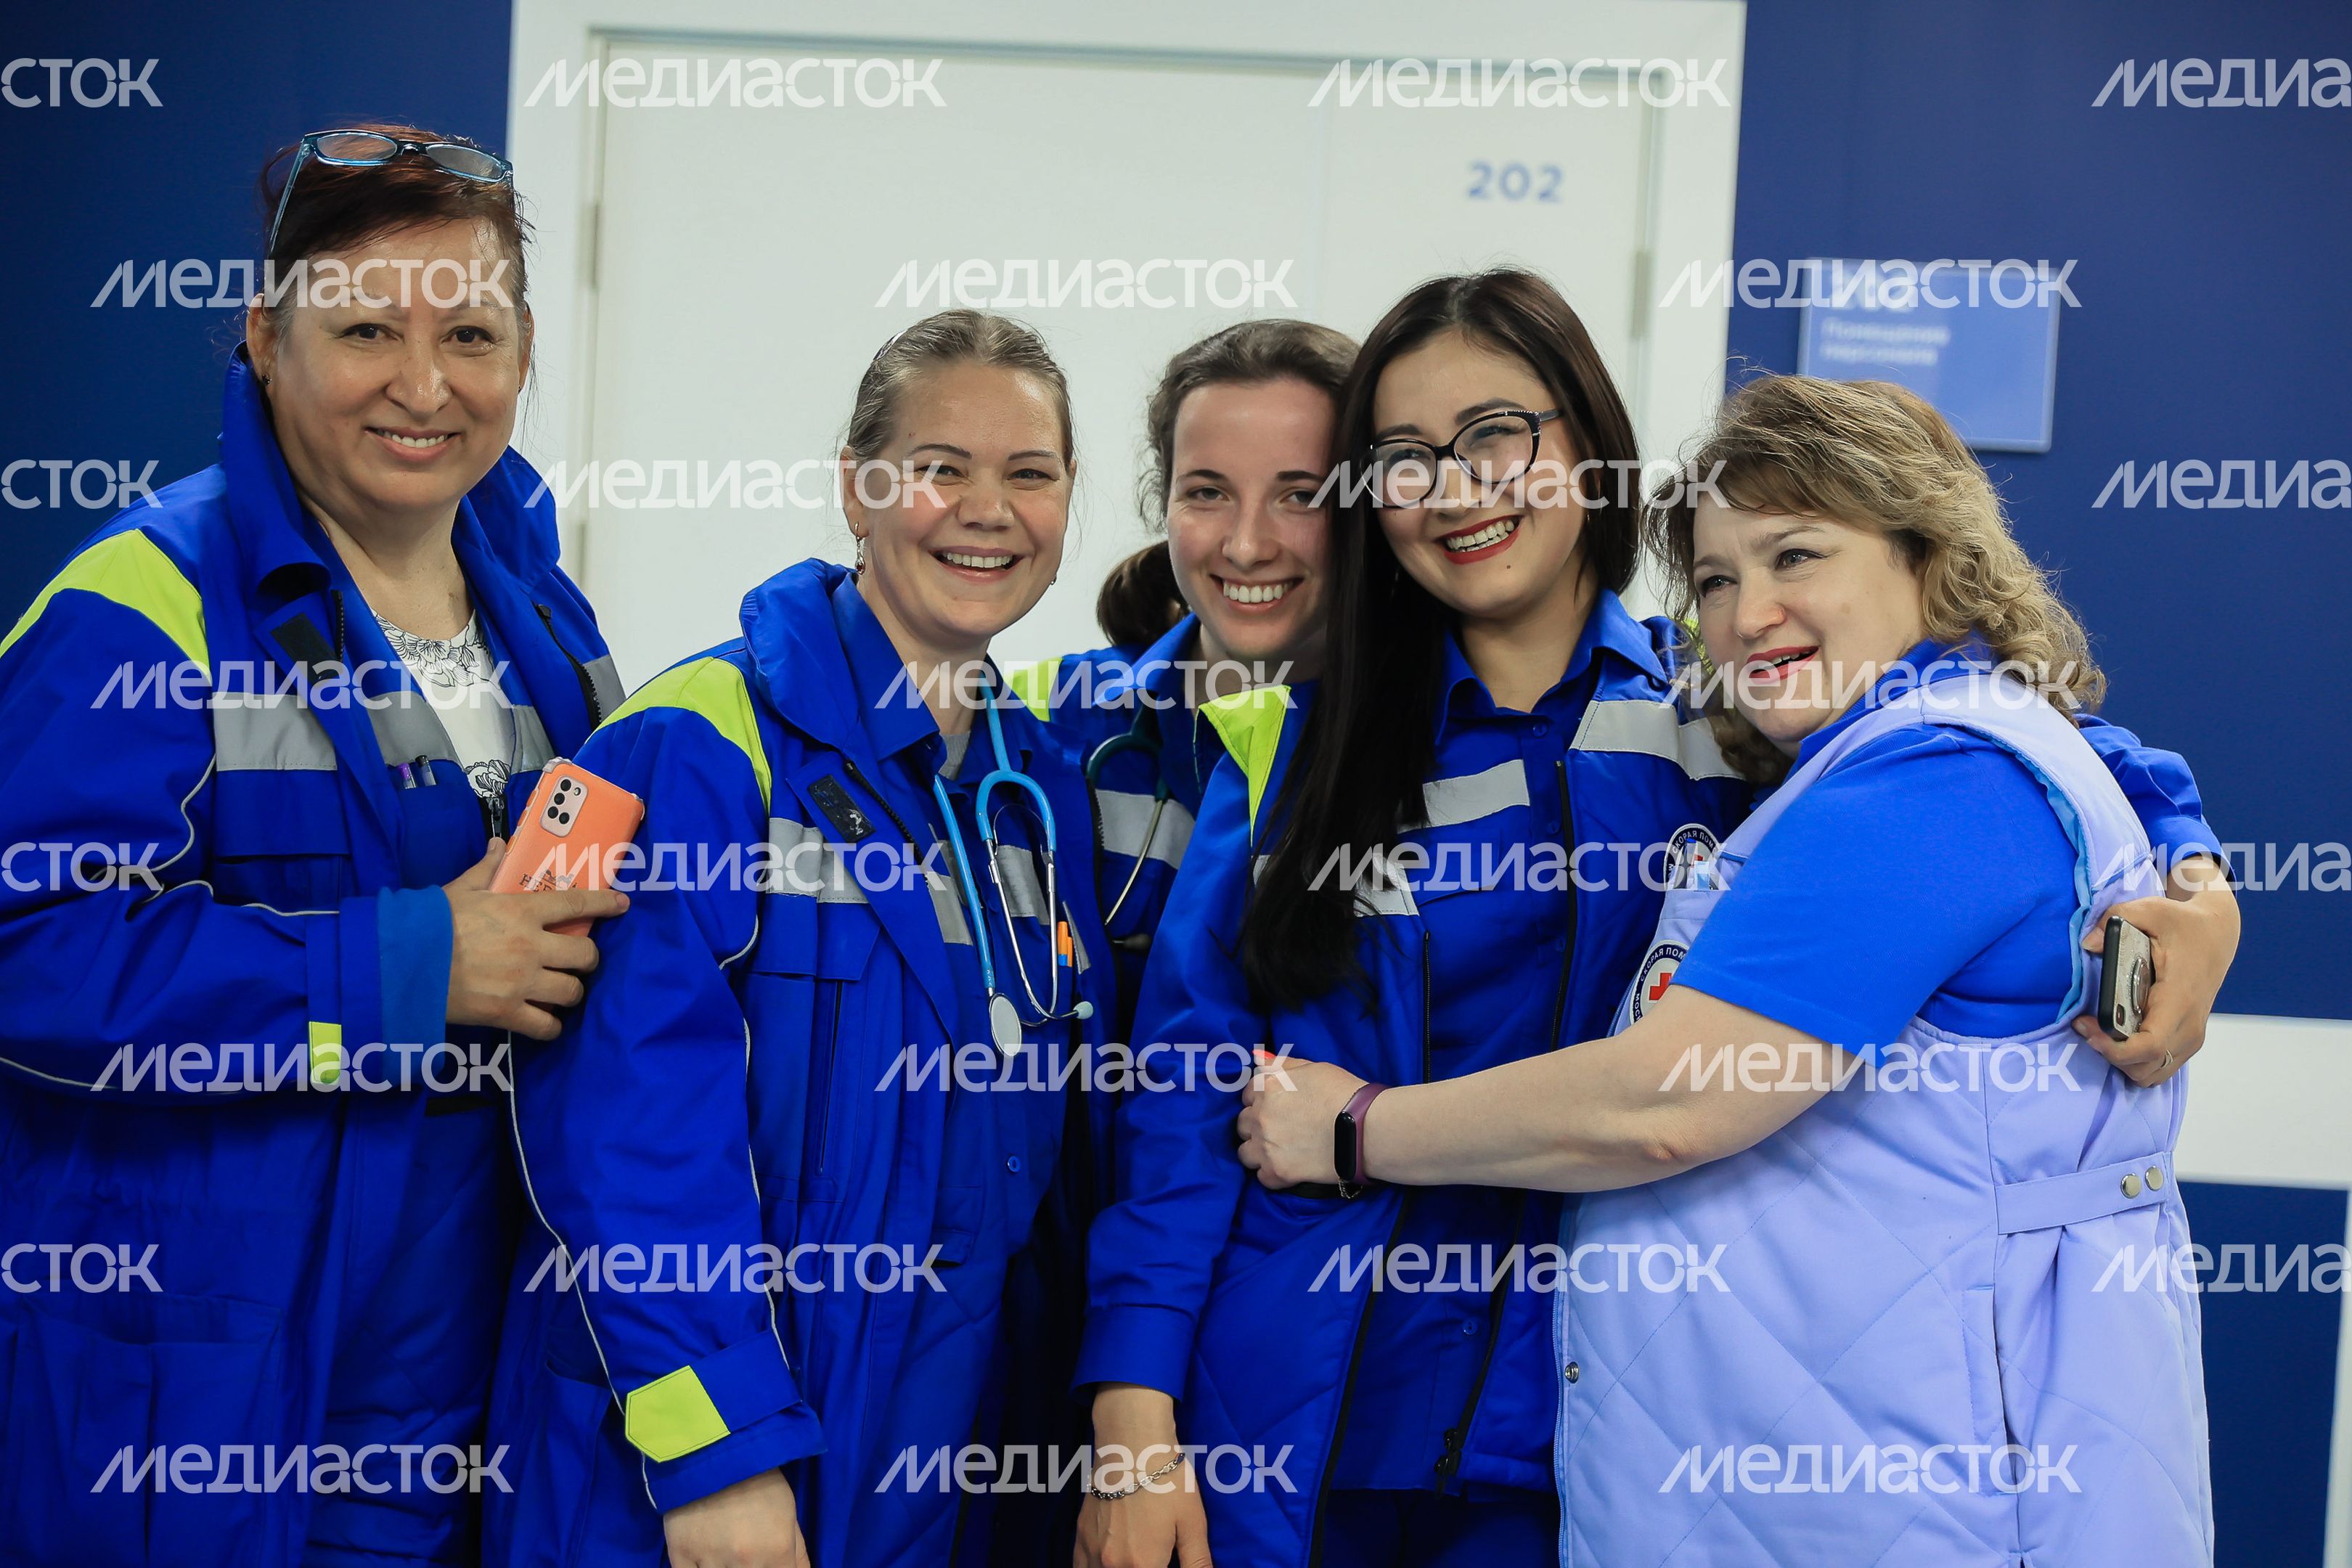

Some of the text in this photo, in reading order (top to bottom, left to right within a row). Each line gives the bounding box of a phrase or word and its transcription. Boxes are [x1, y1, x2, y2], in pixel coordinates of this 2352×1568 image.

[1468, 161, 1562, 203] 202
[1672, 830, 1697, 854] СКОРАЯ
[1641, 948, 1664, 981] СКОРАЯ
